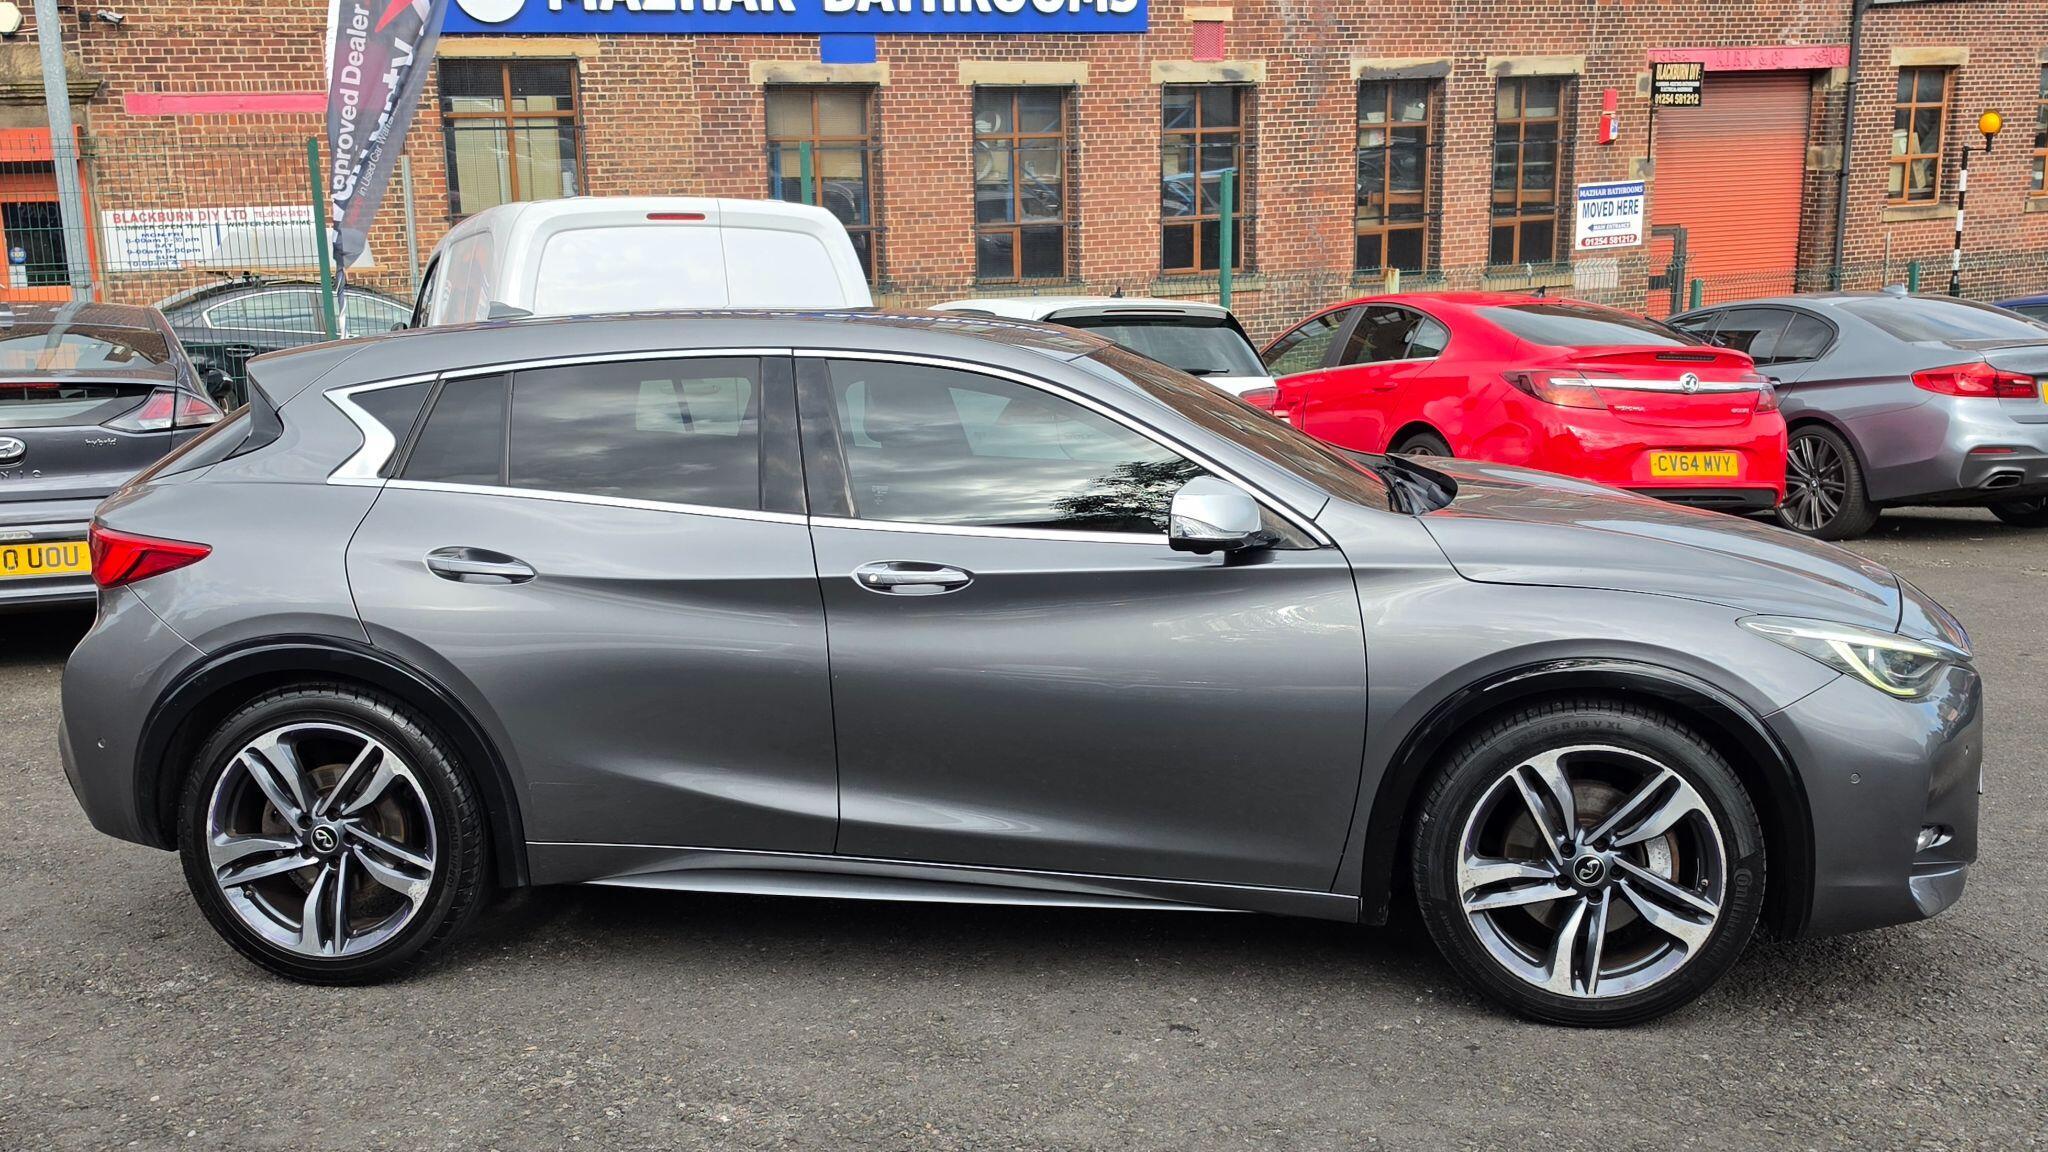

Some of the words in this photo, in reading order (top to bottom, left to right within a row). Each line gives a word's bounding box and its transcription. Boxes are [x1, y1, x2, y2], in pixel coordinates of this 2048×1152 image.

[341, 3, 370, 86] Dealer
[333, 88, 359, 190] pproved
[361, 161, 376, 187] Used
[370, 145, 382, 162] Car
[1608, 185, 1643, 195] BATHROOMS
[113, 211, 193, 224] BLACKBURN
[225, 209, 247, 221] LTD
[1583, 201, 1614, 218] MOVED
[1617, 199, 1639, 216] HERE
[1658, 455, 1699, 472] CV64
[1704, 455, 1731, 472] MVY
[27, 545, 79, 569] UOU
